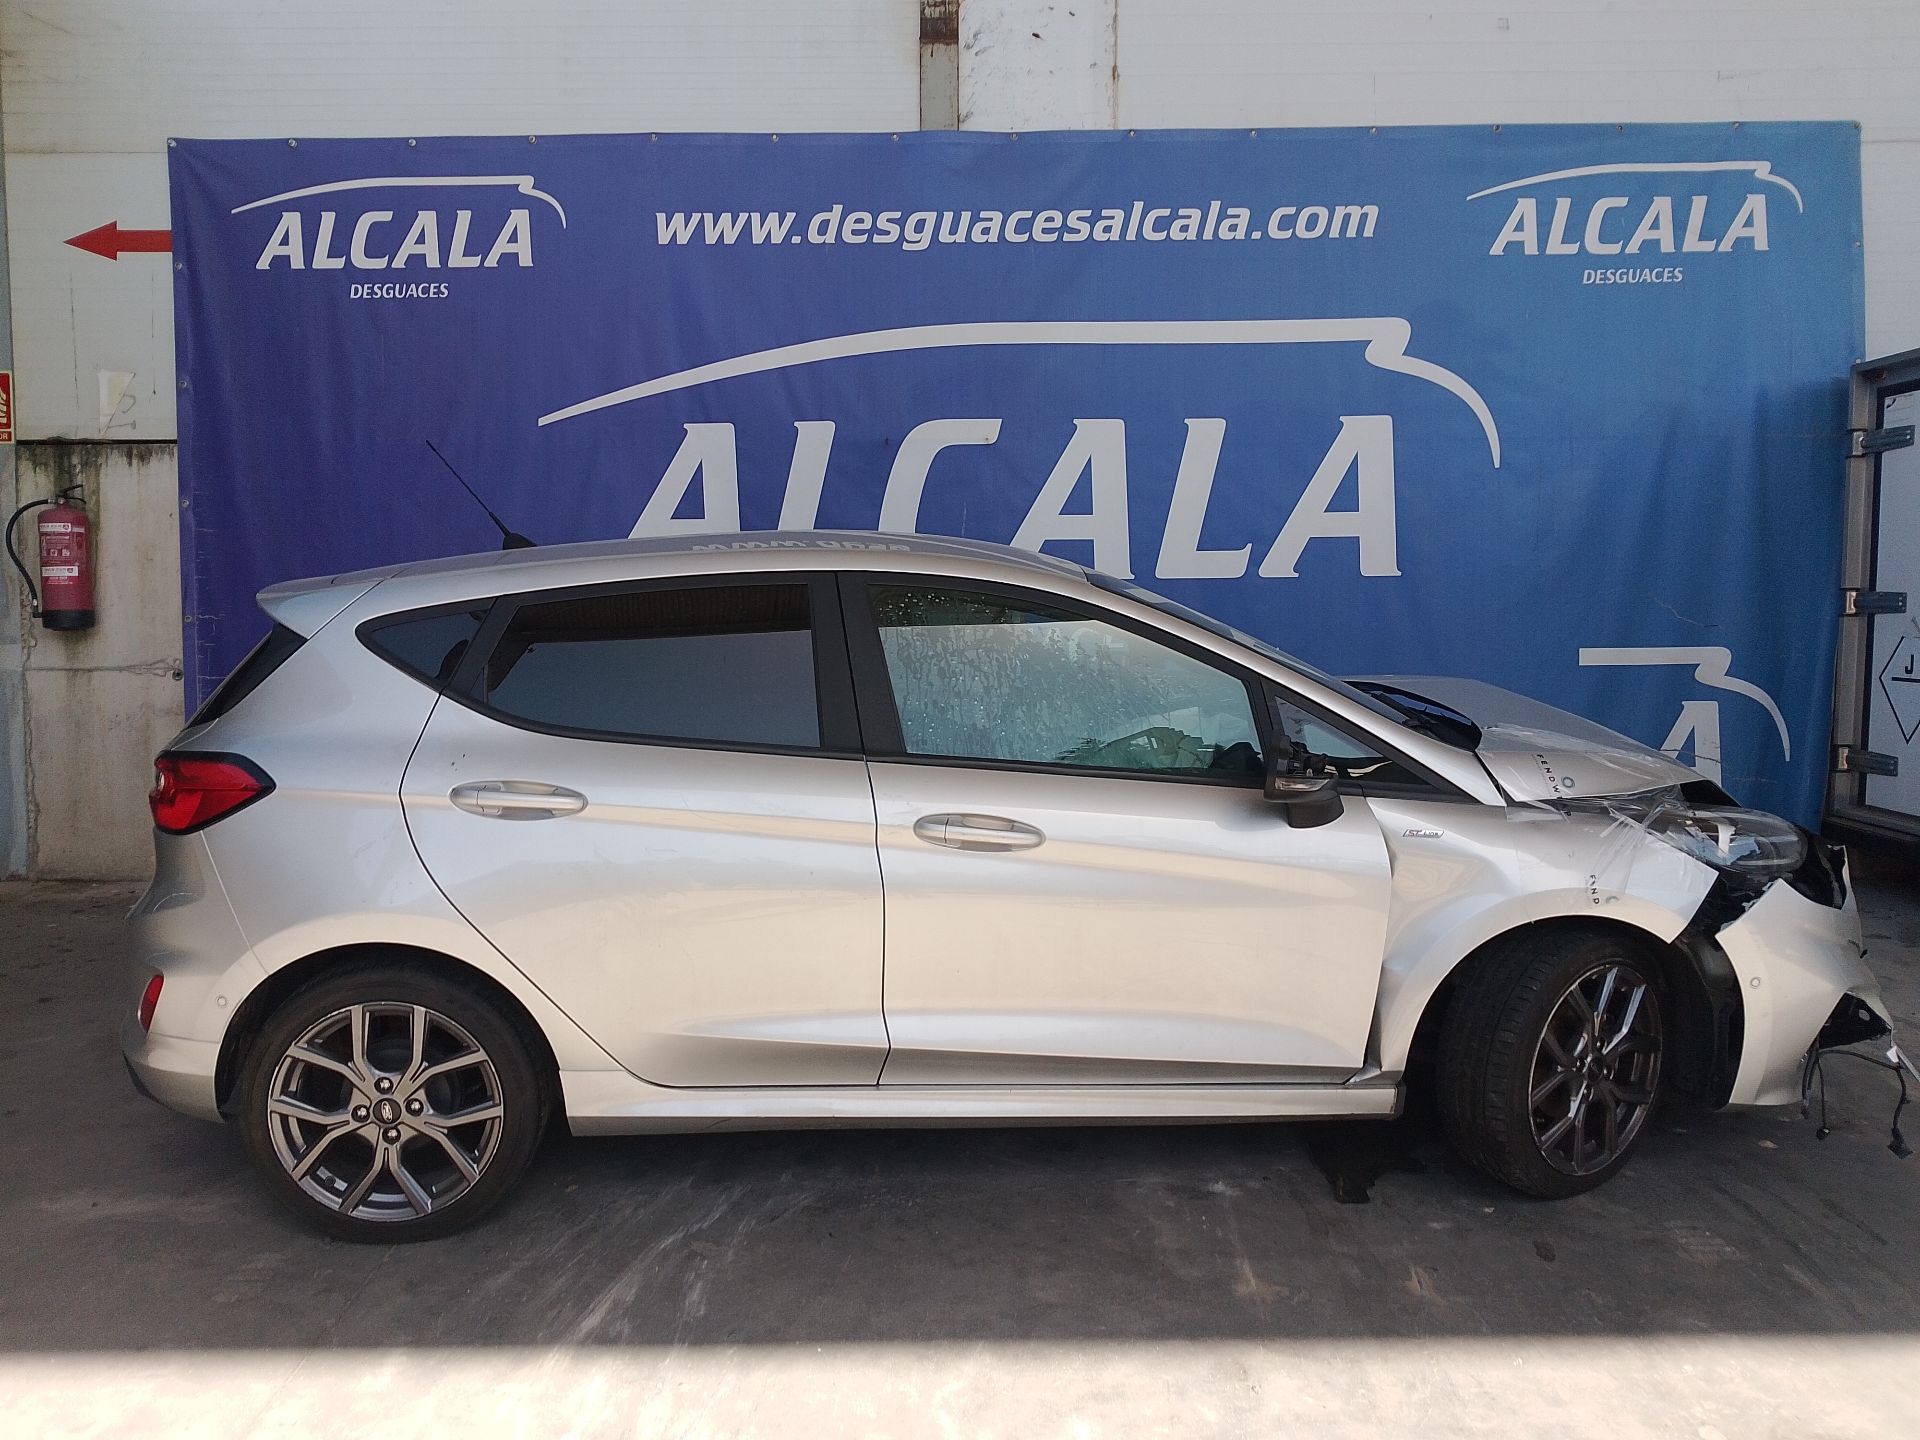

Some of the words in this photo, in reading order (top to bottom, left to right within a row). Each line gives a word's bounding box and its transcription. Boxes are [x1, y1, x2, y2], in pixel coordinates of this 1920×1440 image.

[256, 209, 535, 270] ALCALA
[655, 200, 1379, 251] www.desguacesalcala.com
[1489, 193, 1770, 256] ALCALA
[350, 283, 449, 299] DESGUACES
[1582, 267, 1683, 284] DESGUACES
[628, 415, 1402, 580] ALCALA
